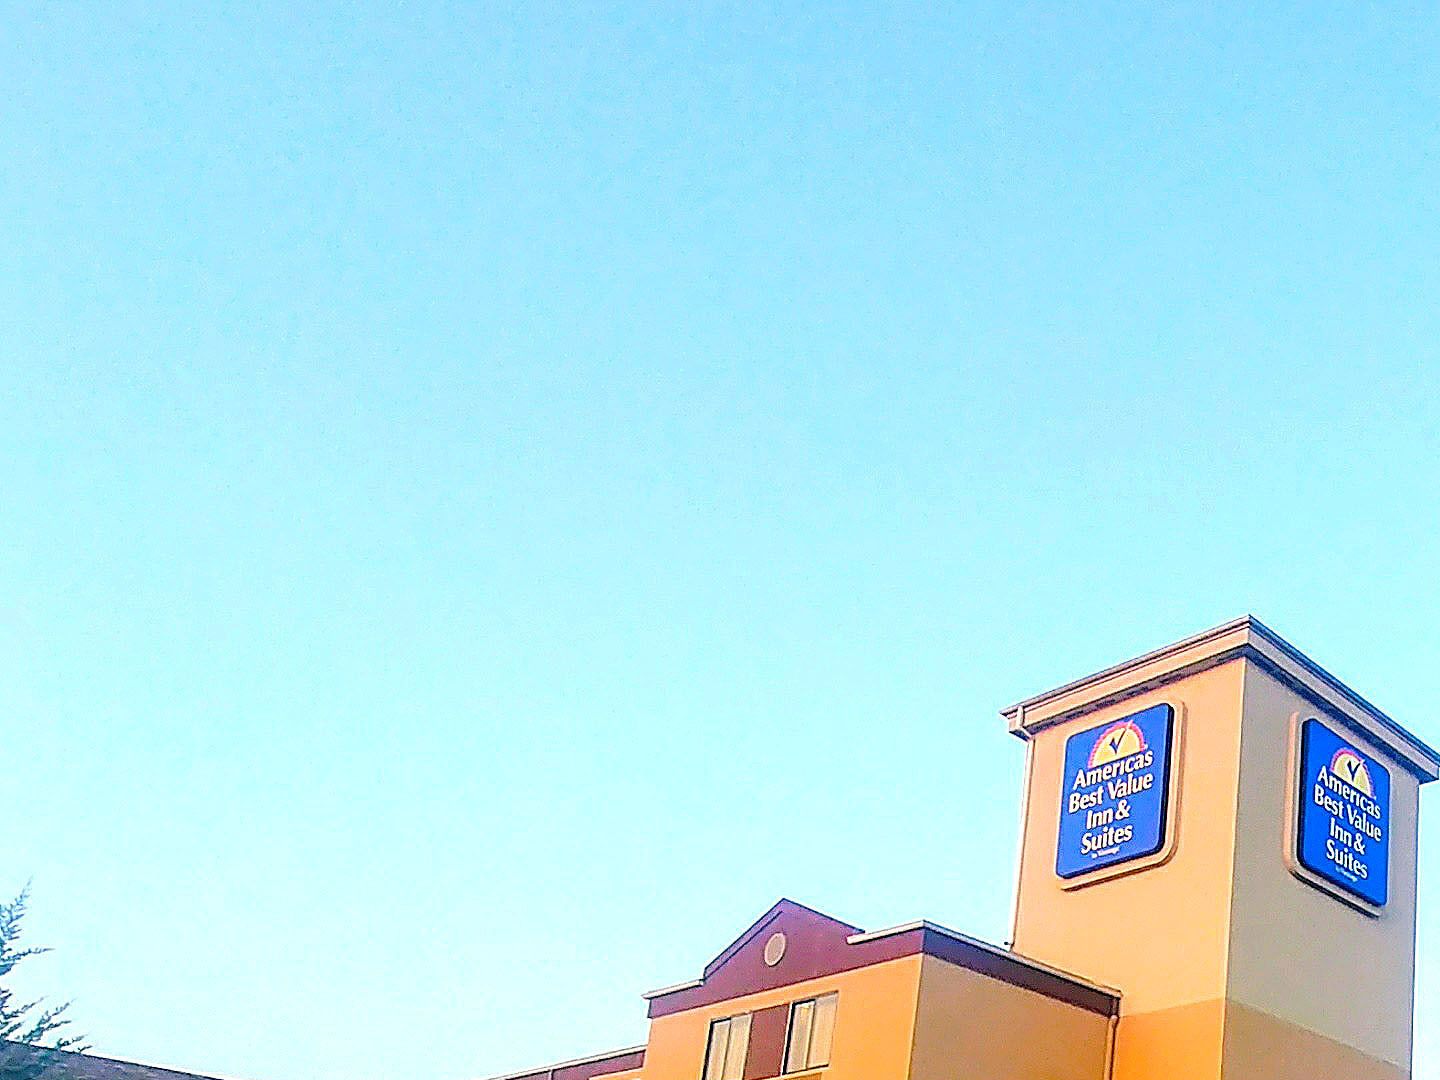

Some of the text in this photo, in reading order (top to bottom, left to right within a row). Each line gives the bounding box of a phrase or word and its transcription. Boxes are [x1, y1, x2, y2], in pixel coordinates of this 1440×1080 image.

[1073, 750, 1154, 790] Americas
[1068, 773, 1154, 815] Best Value
[1317, 765, 1381, 819] Americas
[1086, 799, 1131, 830] Inn &
[1314, 783, 1382, 842] Best Value
[1080, 825, 1133, 855] Suites
[1330, 817, 1366, 855] Inn &
[1326, 839, 1368, 878] Suites
